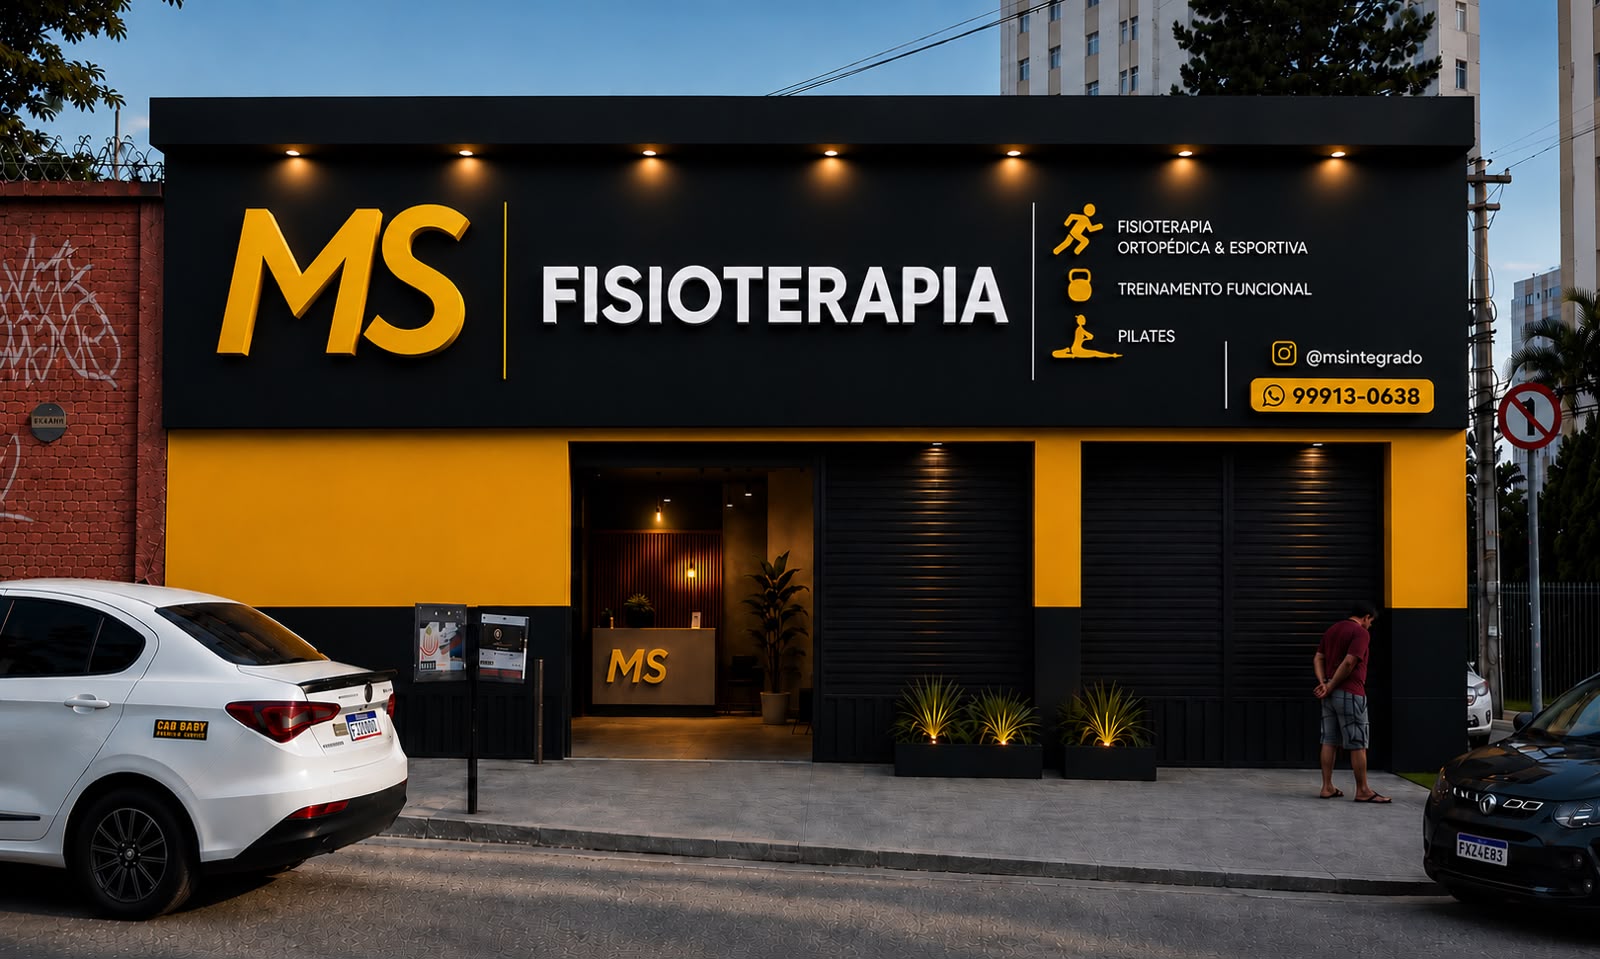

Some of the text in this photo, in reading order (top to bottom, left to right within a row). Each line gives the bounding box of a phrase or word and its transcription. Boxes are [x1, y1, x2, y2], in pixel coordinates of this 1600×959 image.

[1118, 219, 1213, 234] FISIOTERAPIA
[1118, 237, 1309, 255] ORTOPÉDICA & ESPORTIVA
[217, 204, 471, 357] MS
[1118, 282, 1313, 297] TREINAMENTO FUNCIONAL
[542, 265, 1010, 326] FISIOTERAPIA
[1118, 329, 1176, 343] PILATES
[1306, 349, 1423, 368] @msintegrado
[1292, 387, 1420, 405] 99913-0638
[606, 648, 669, 683] MS
[180, 722, 206, 732] BABY
